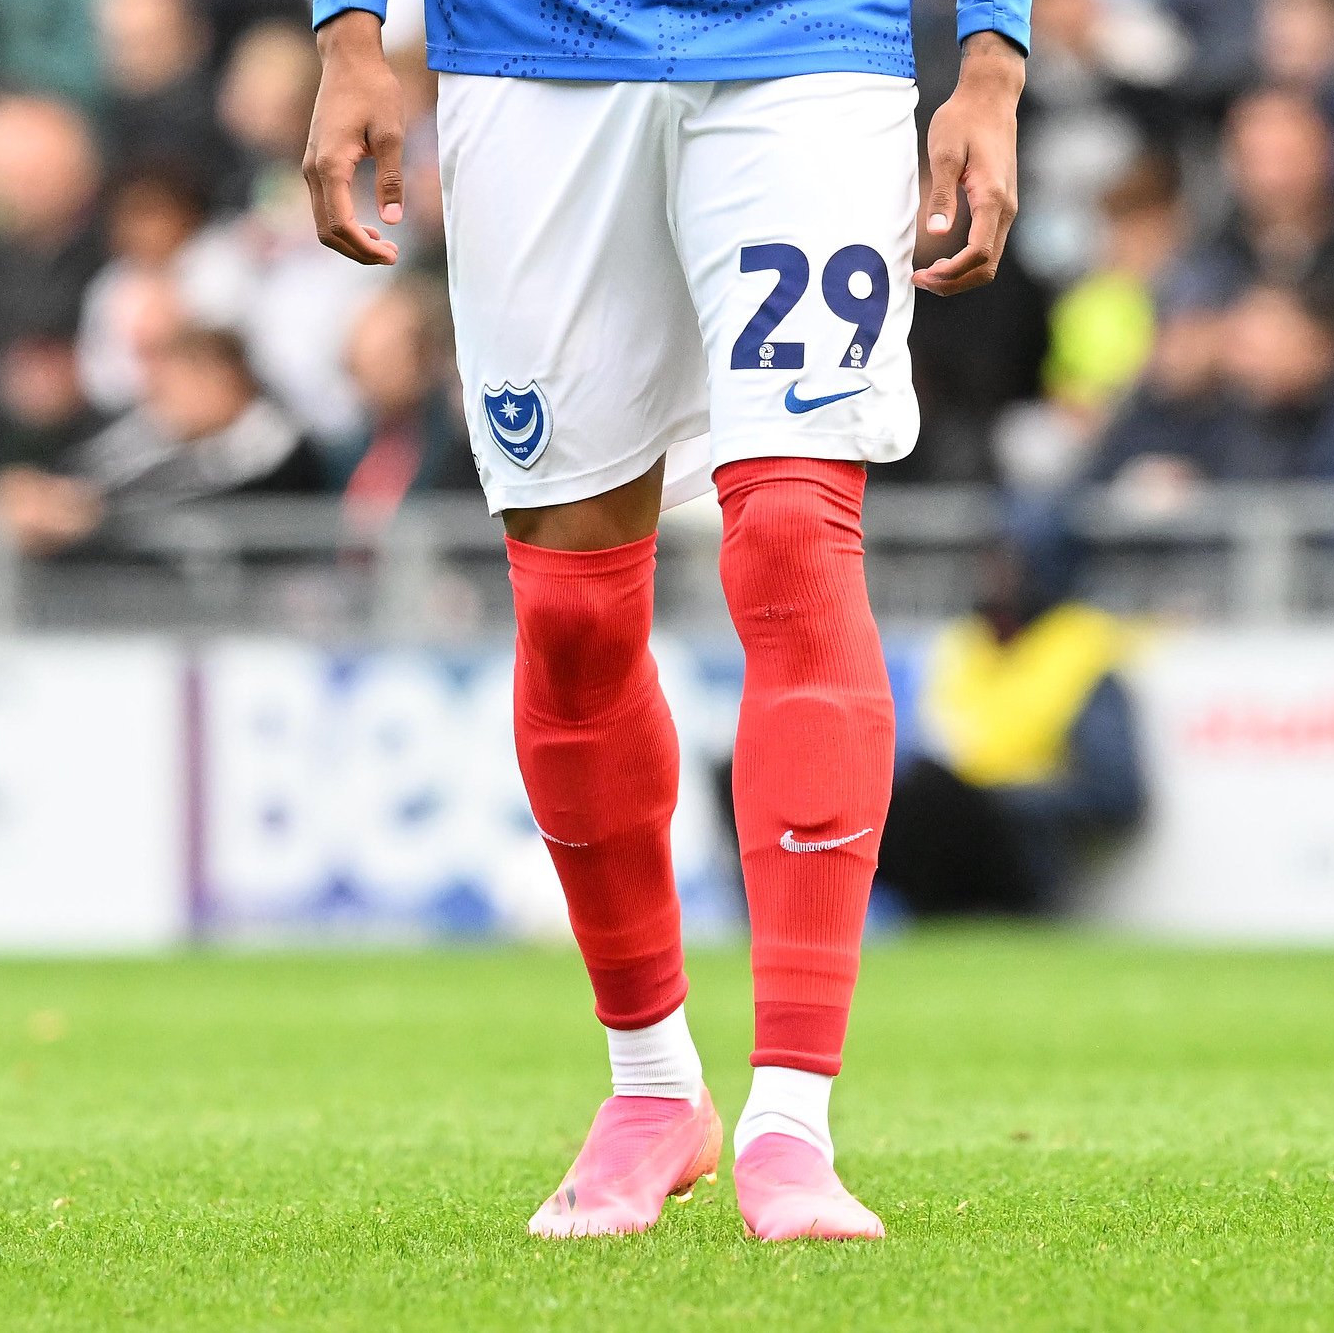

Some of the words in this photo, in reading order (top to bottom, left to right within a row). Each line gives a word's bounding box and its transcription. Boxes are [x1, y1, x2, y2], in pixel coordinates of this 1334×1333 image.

[730, 242, 890, 370] 29
[759, 359, 774, 368] EFL
[850, 359, 863, 368] EFL
